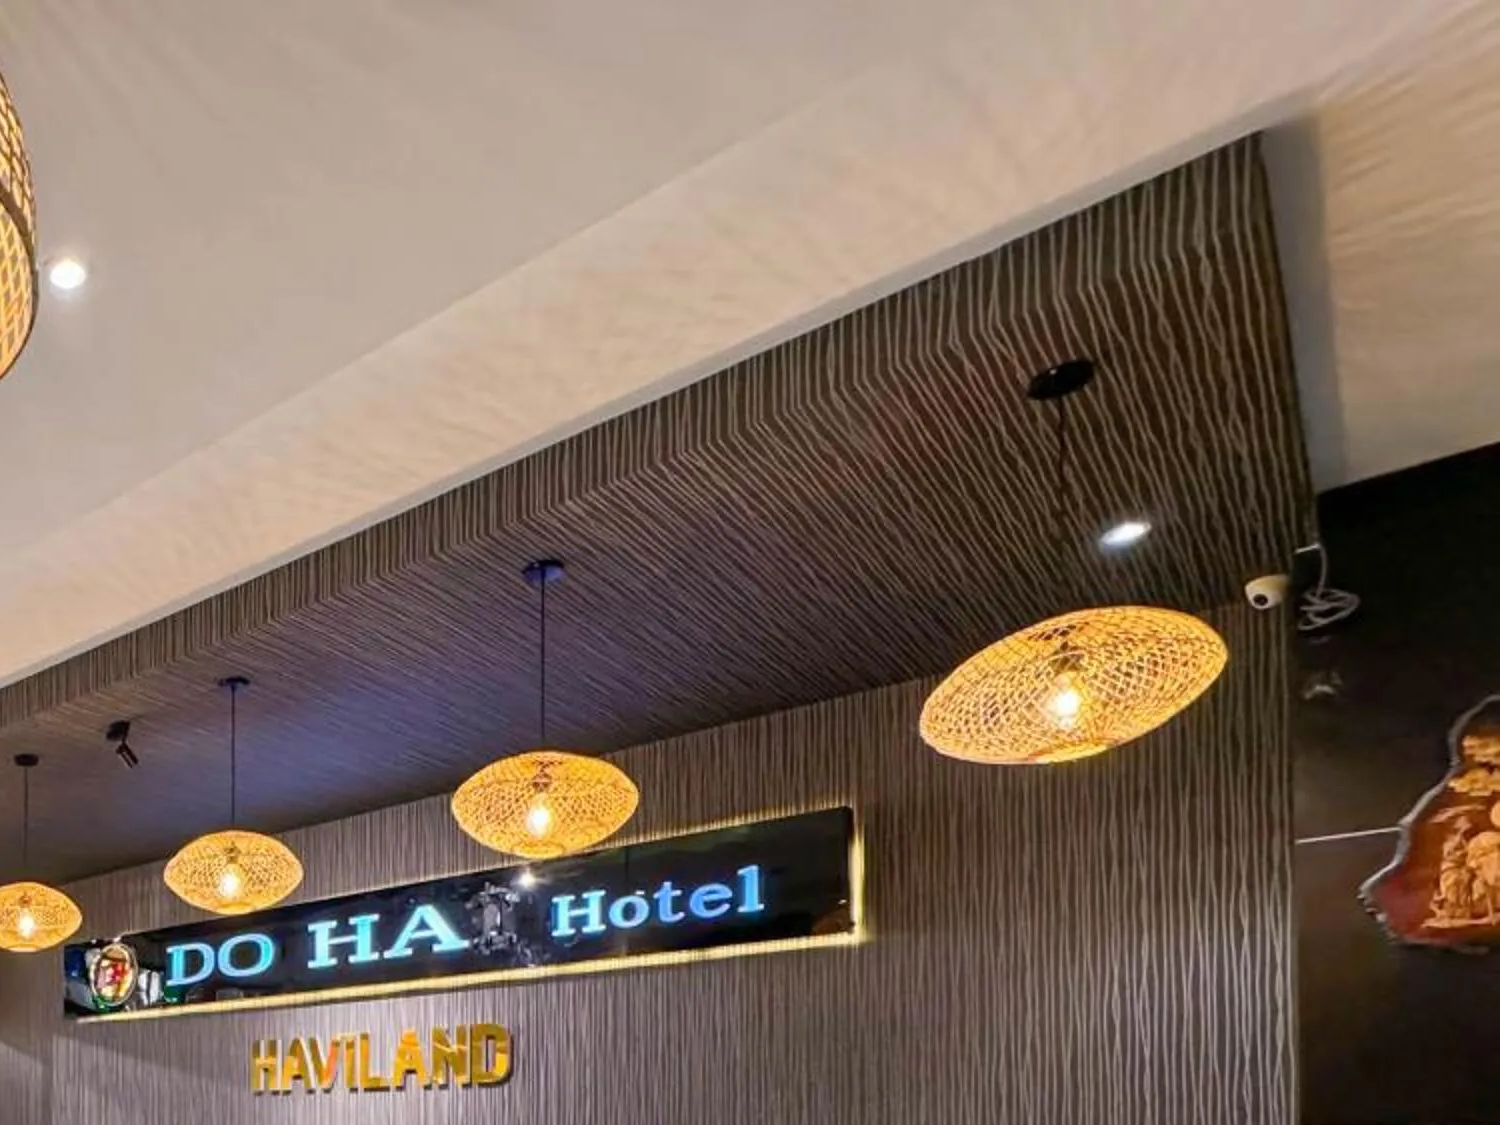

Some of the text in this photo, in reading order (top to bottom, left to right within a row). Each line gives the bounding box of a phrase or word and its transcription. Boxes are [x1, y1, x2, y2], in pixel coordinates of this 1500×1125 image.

[167, 932, 275, 987] DO
[550, 866, 764, 936] Hotel
[252, 1023, 512, 1094] HAVILAND
